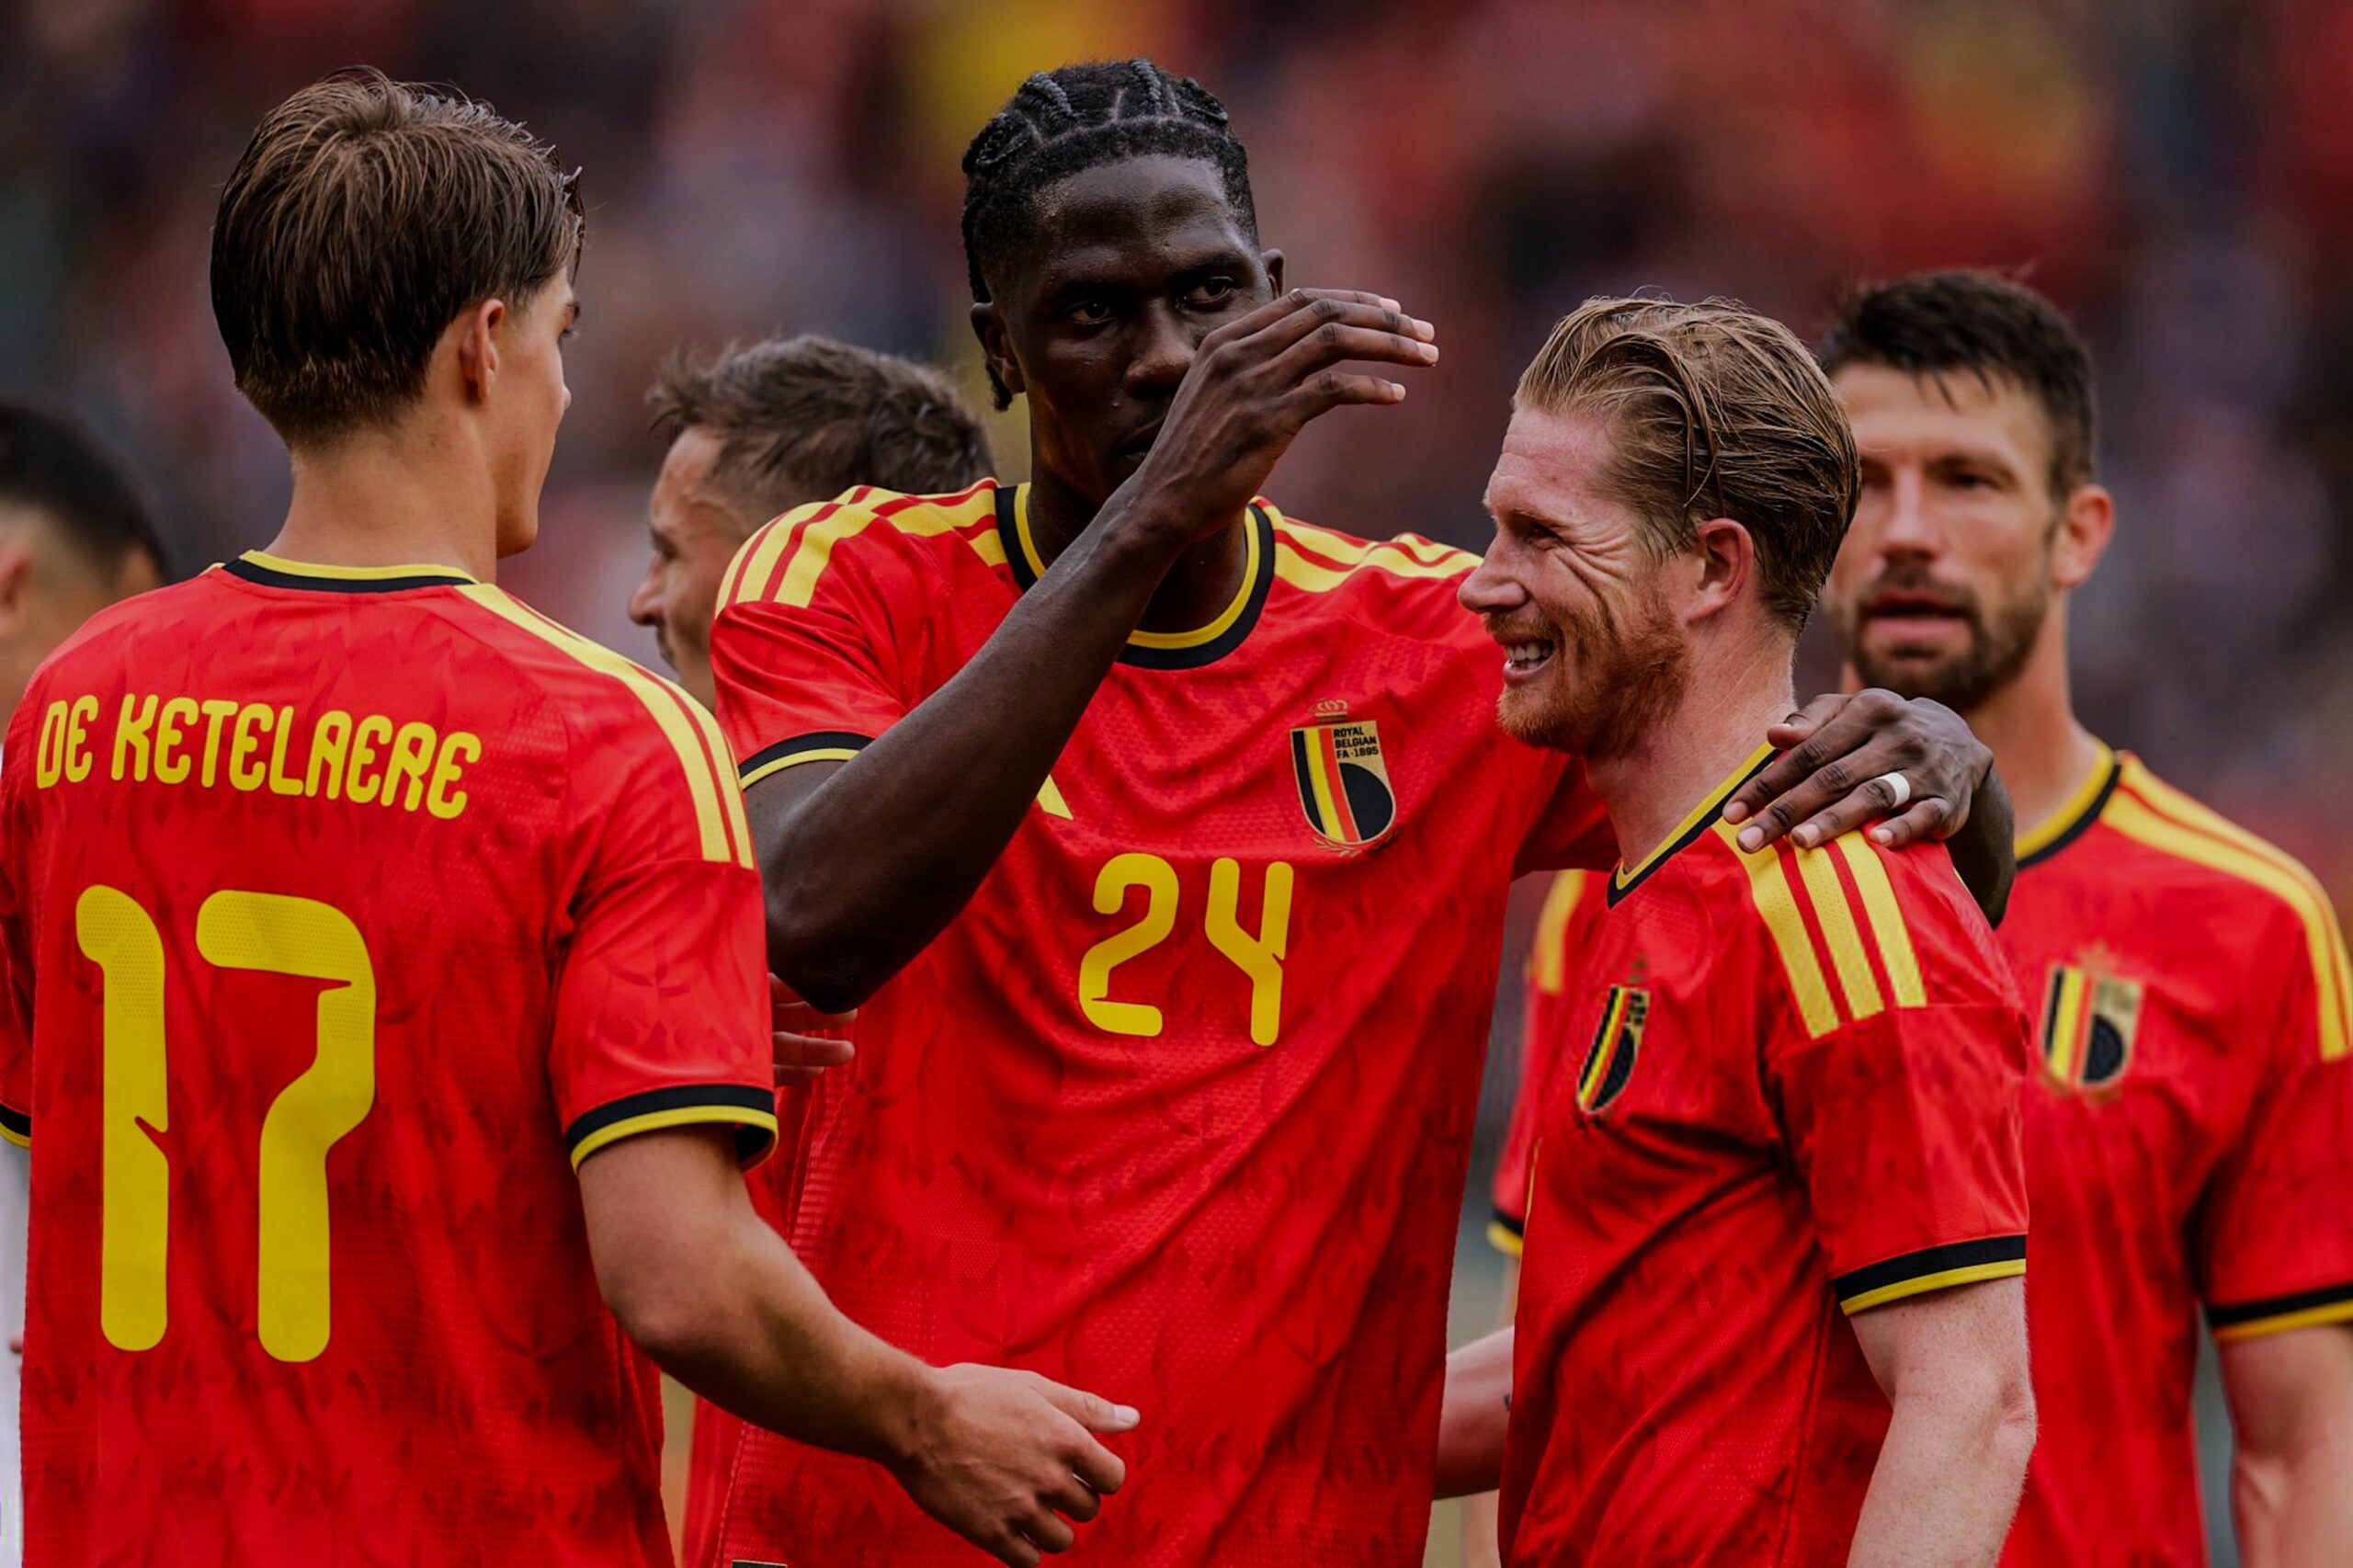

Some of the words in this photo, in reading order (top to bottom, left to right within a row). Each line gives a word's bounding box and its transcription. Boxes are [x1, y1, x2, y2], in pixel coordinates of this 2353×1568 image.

[36, 694, 99, 789] DE
[111, 693, 482, 819] KETELAERE
[1334, 726, 1364, 737] ROYAL
[1335, 735, 1377, 749] BELGIAN
[1078, 852, 1294, 1047] 24
[75, 885, 376, 1362] 17
